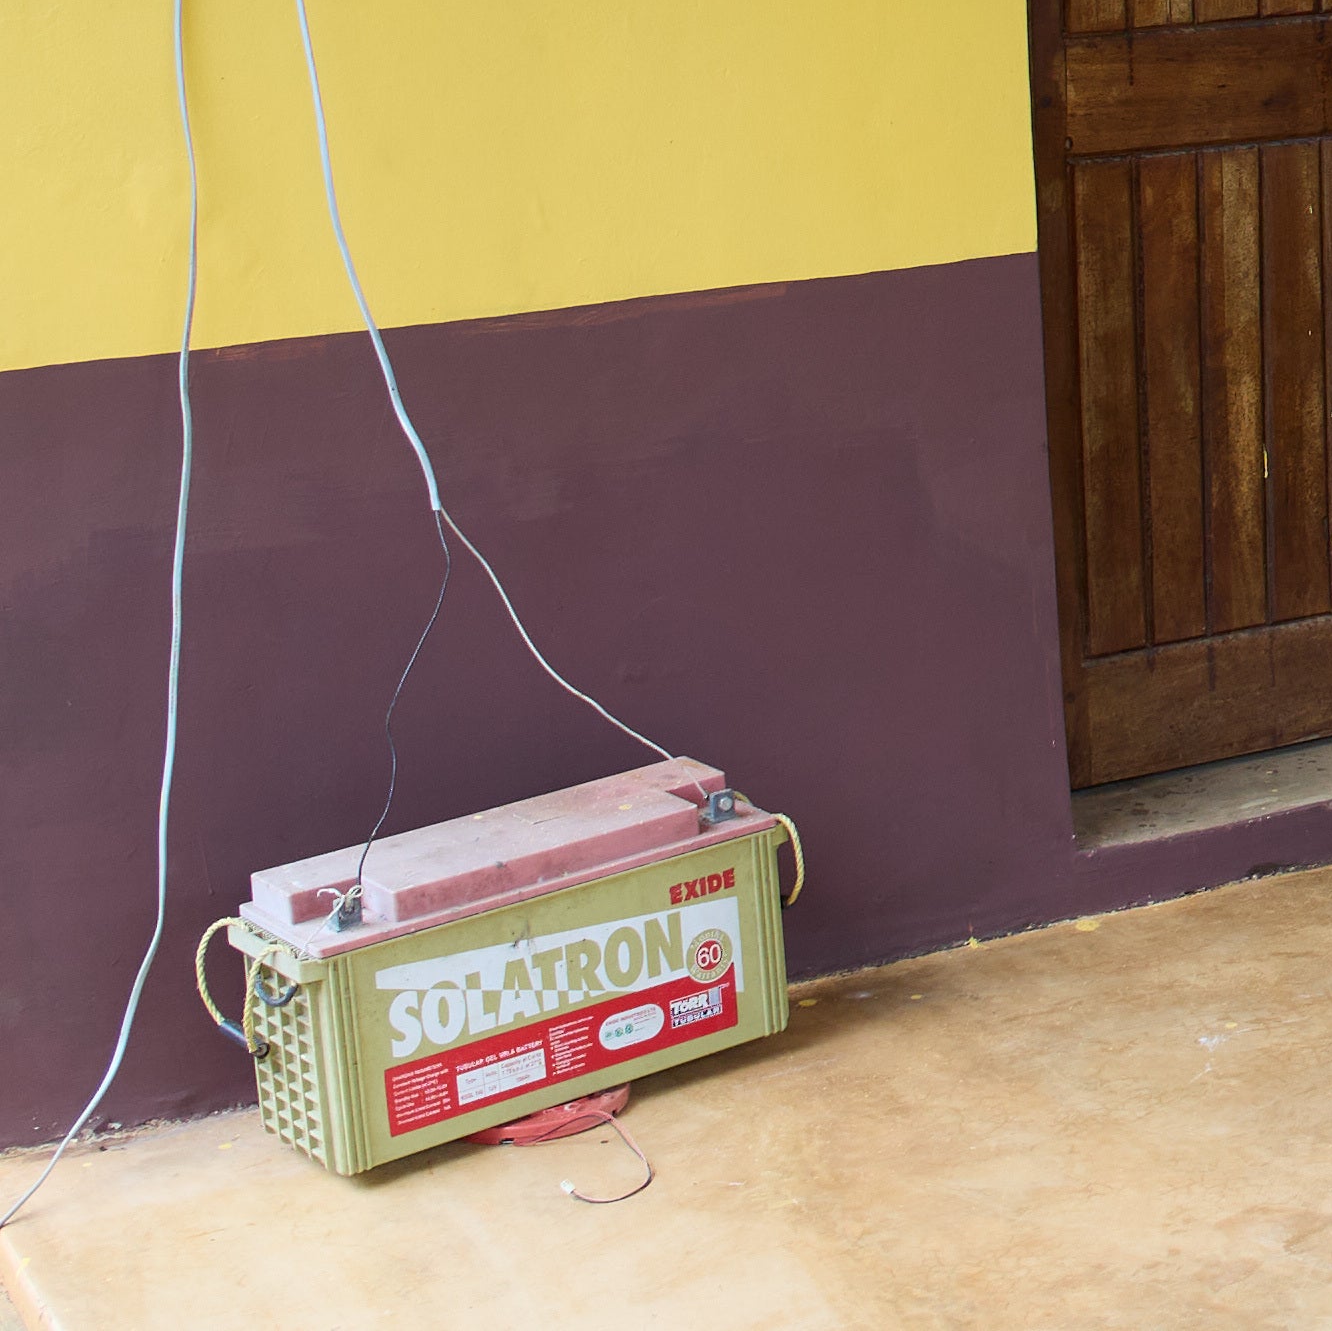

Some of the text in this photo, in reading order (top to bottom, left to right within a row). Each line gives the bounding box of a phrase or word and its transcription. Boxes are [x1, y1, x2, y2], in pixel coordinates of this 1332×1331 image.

[669, 868, 736, 905] EXIDE
[697, 943, 722, 968] 60
[389, 911, 686, 1058] SOLATRON
[516, 1040, 543, 1053] BATTERY
